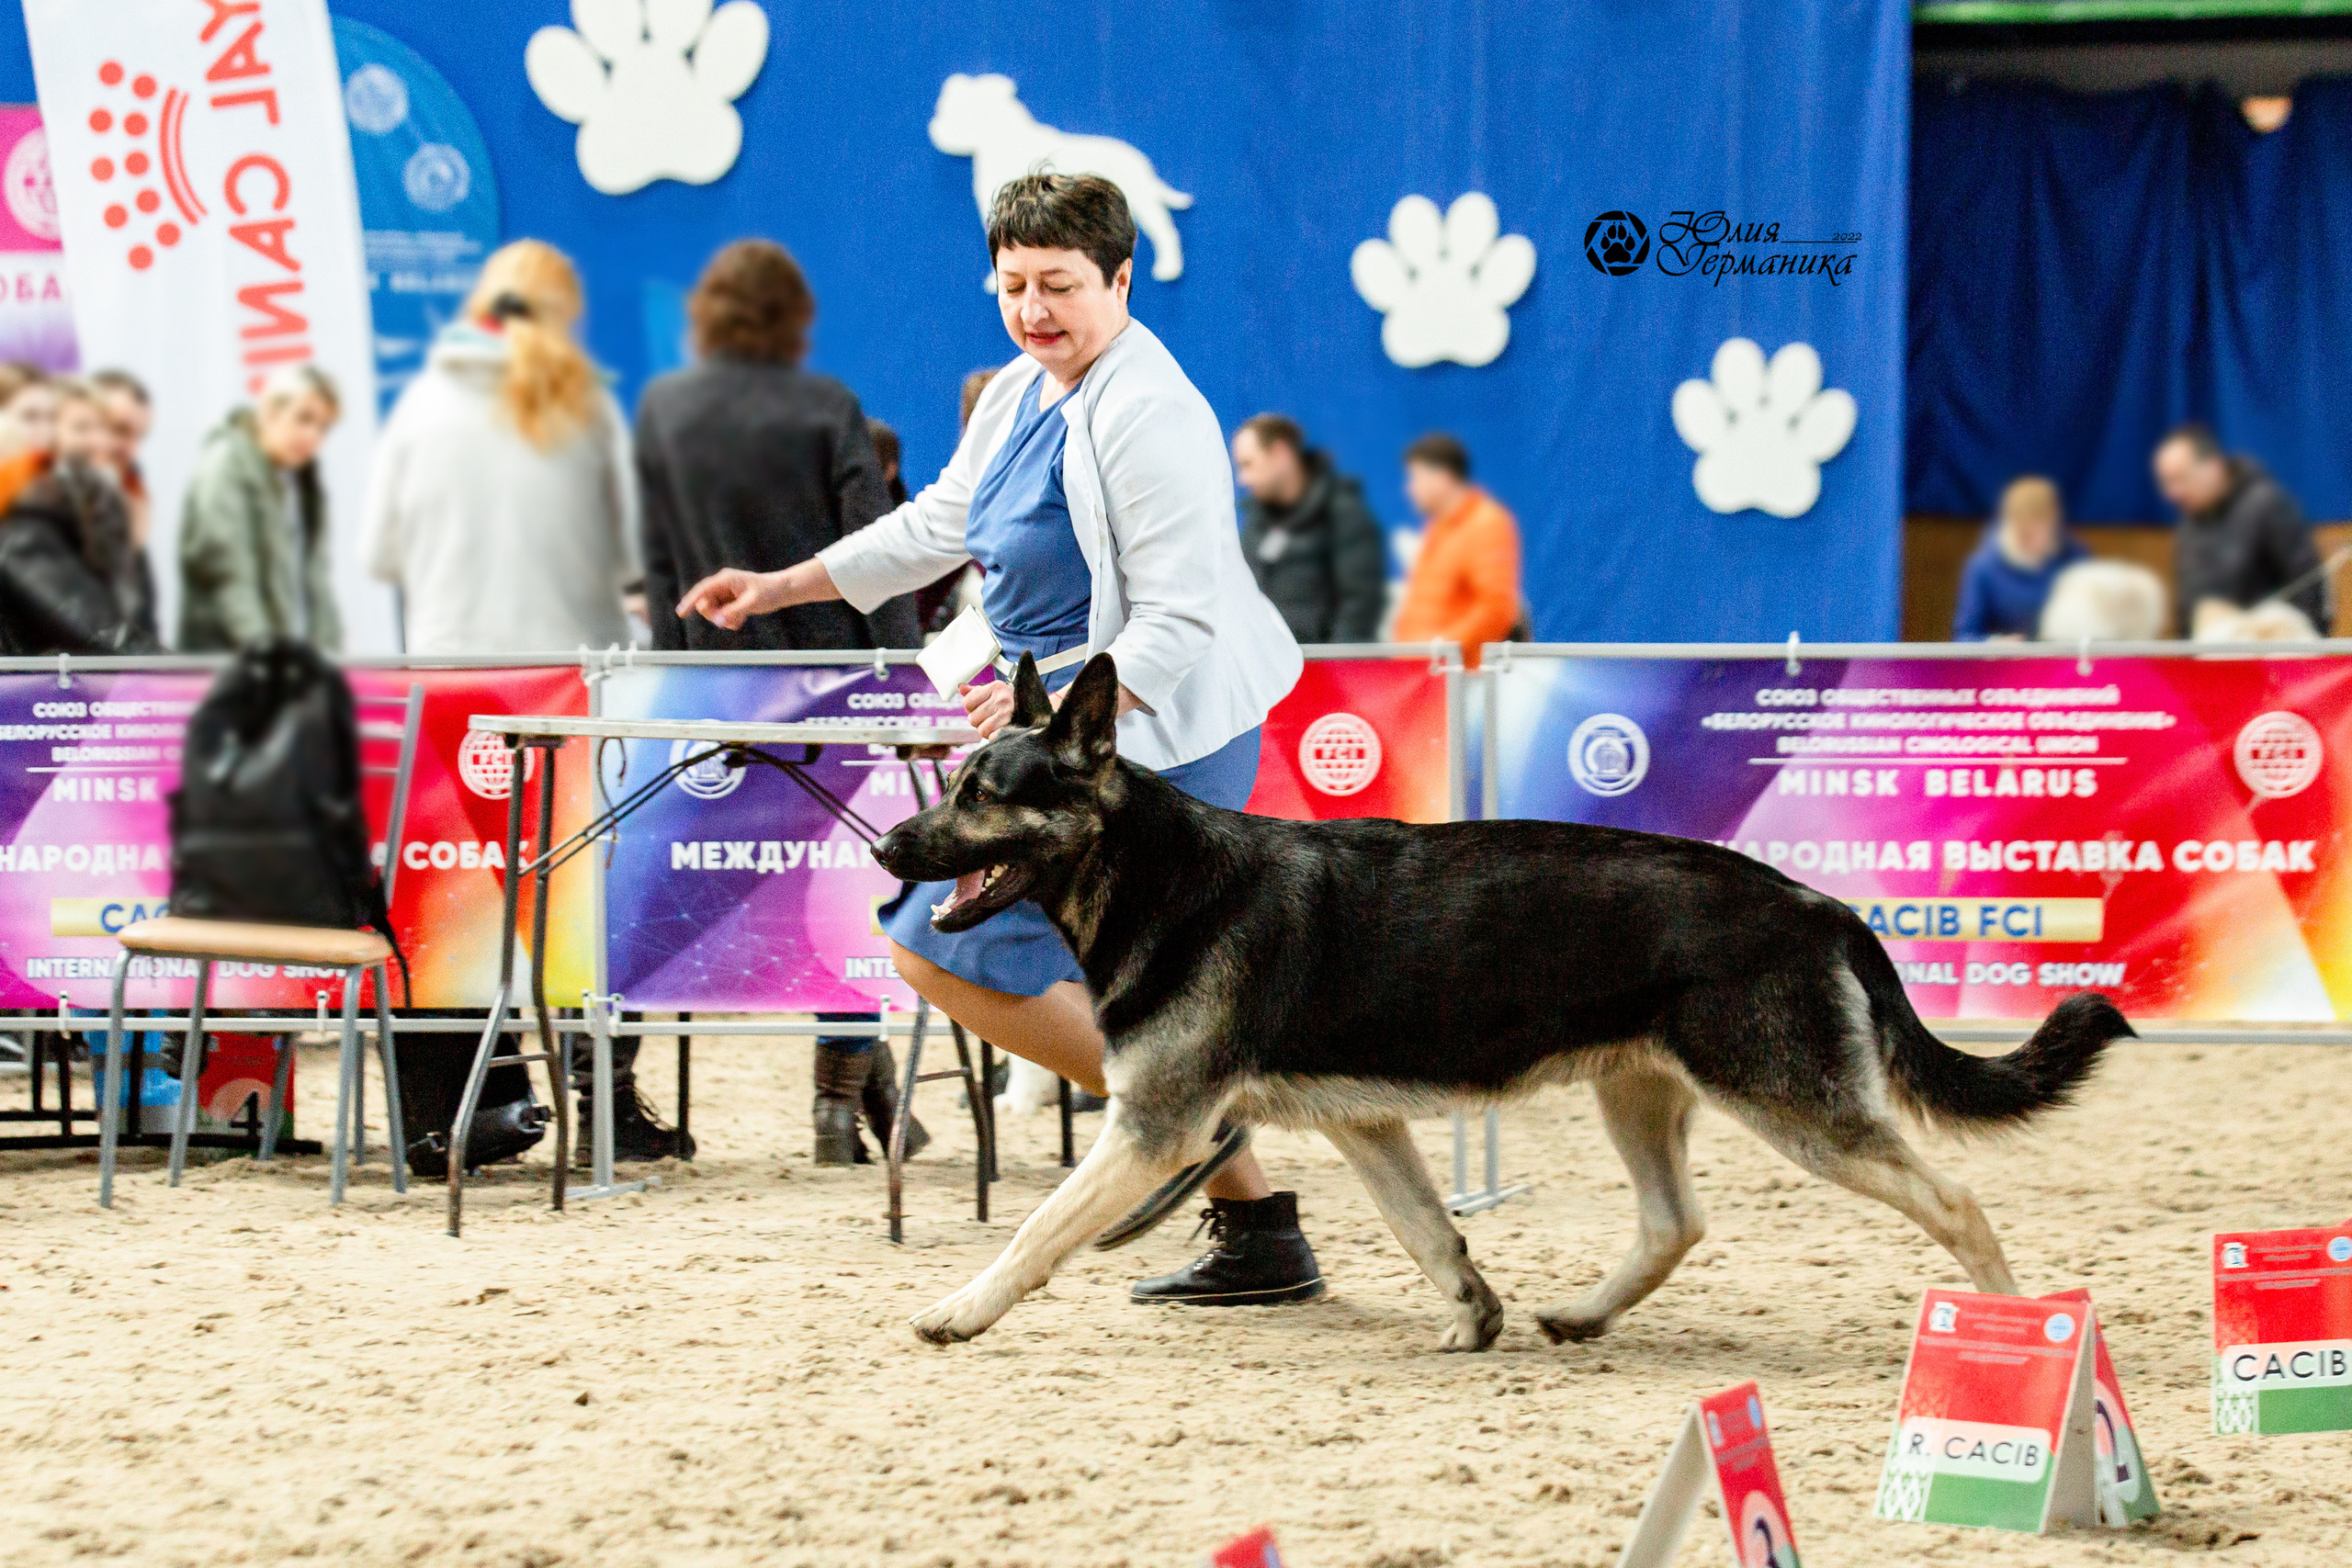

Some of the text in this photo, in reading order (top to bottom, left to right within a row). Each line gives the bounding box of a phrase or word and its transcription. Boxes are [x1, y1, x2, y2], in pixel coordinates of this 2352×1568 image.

[32, 702, 87, 717] СОЮЗ
[846, 693, 906, 709] СОЮЗ
[1756, 689, 1817, 705] СОЮЗ
[52, 777, 159, 802] MINSK
[1778, 769, 2098, 796] MINSK BELARUS
[0, 843, 171, 874] НАРОДНА
[1943, 840, 2165, 872] ВЫСТАВКА
[2172, 840, 2316, 872] СОБАК
[1979, 904, 2043, 937] FCI
[1965, 962, 2031, 986] DOG
[2038, 962, 2128, 987] SHOW
[2233, 1349, 2347, 1382] CACIB
[1907, 1433, 2041, 1468] R. CACIB
